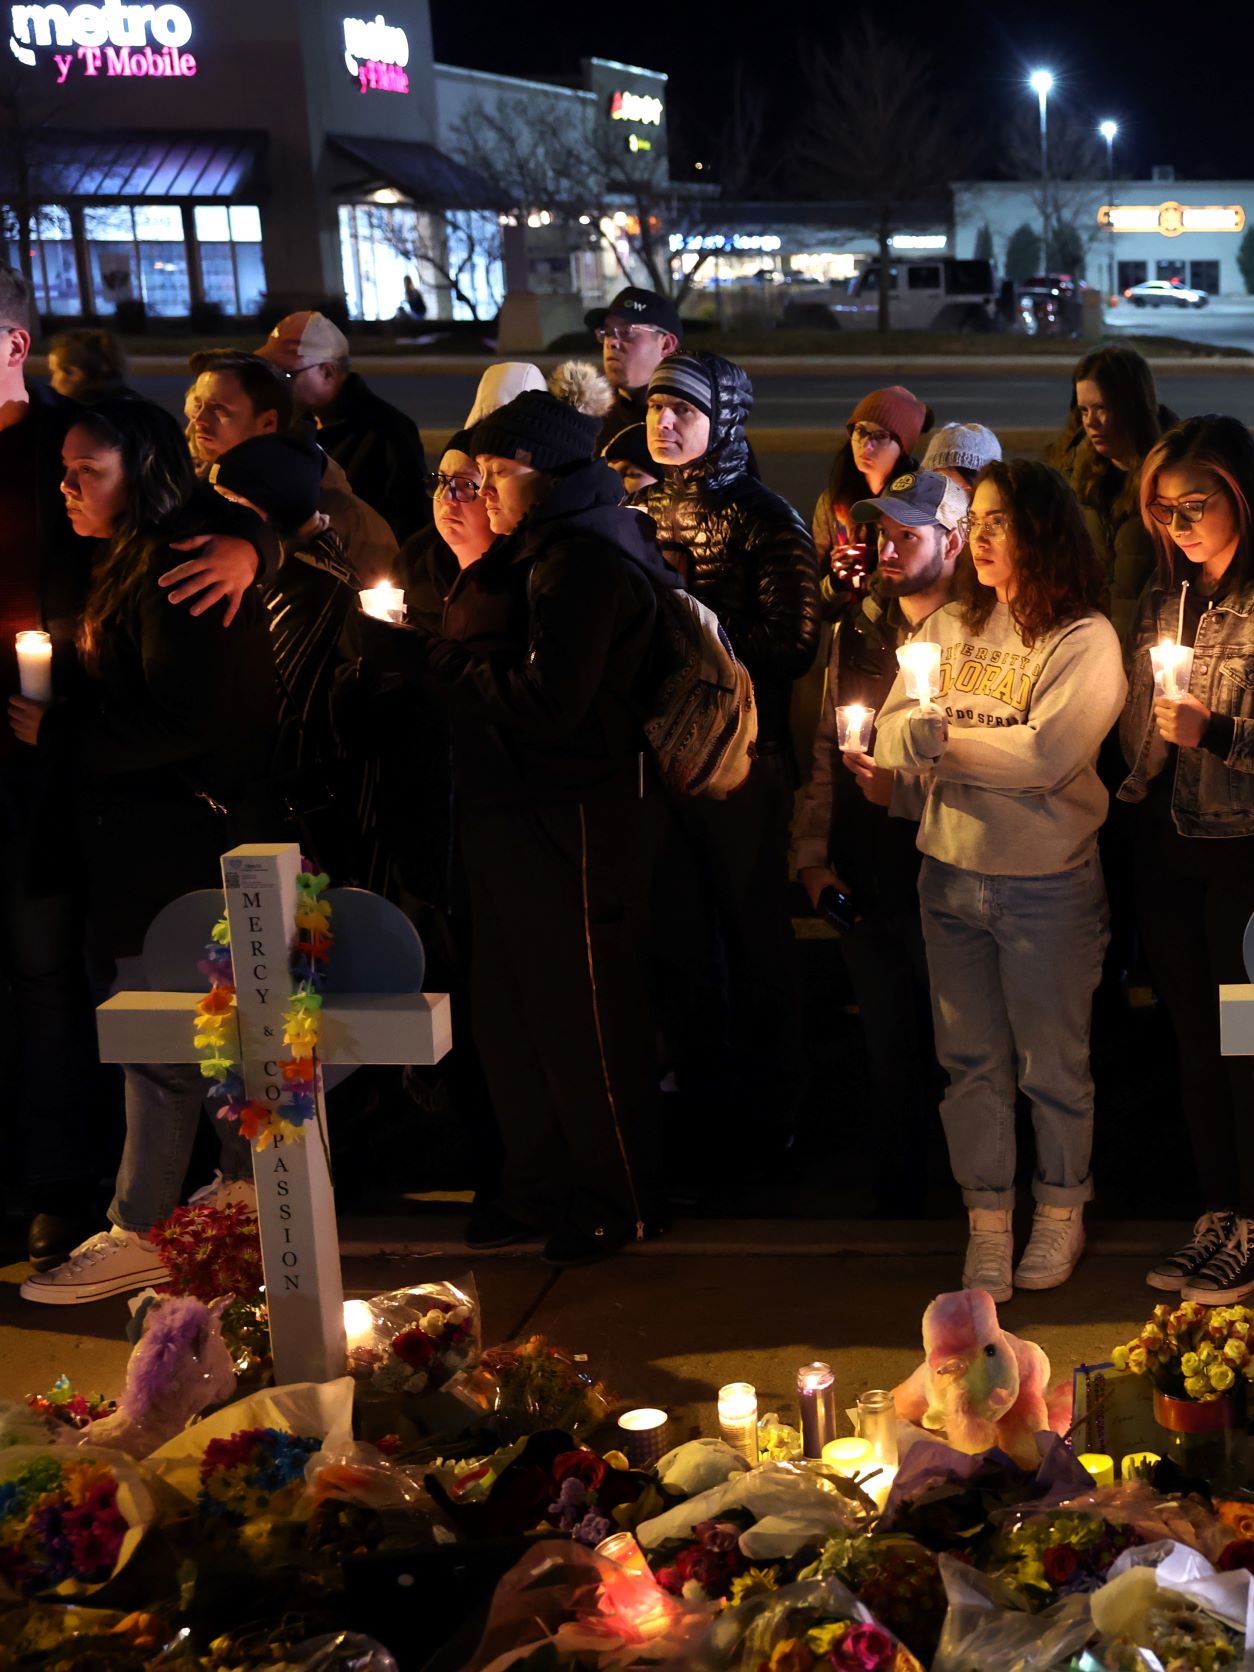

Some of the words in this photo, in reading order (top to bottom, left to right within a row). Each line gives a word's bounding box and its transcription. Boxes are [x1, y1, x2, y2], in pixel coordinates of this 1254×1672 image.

[11, 0, 192, 47] metro
[243, 893, 269, 1004] MERCY
[263, 1026, 274, 1037] &
